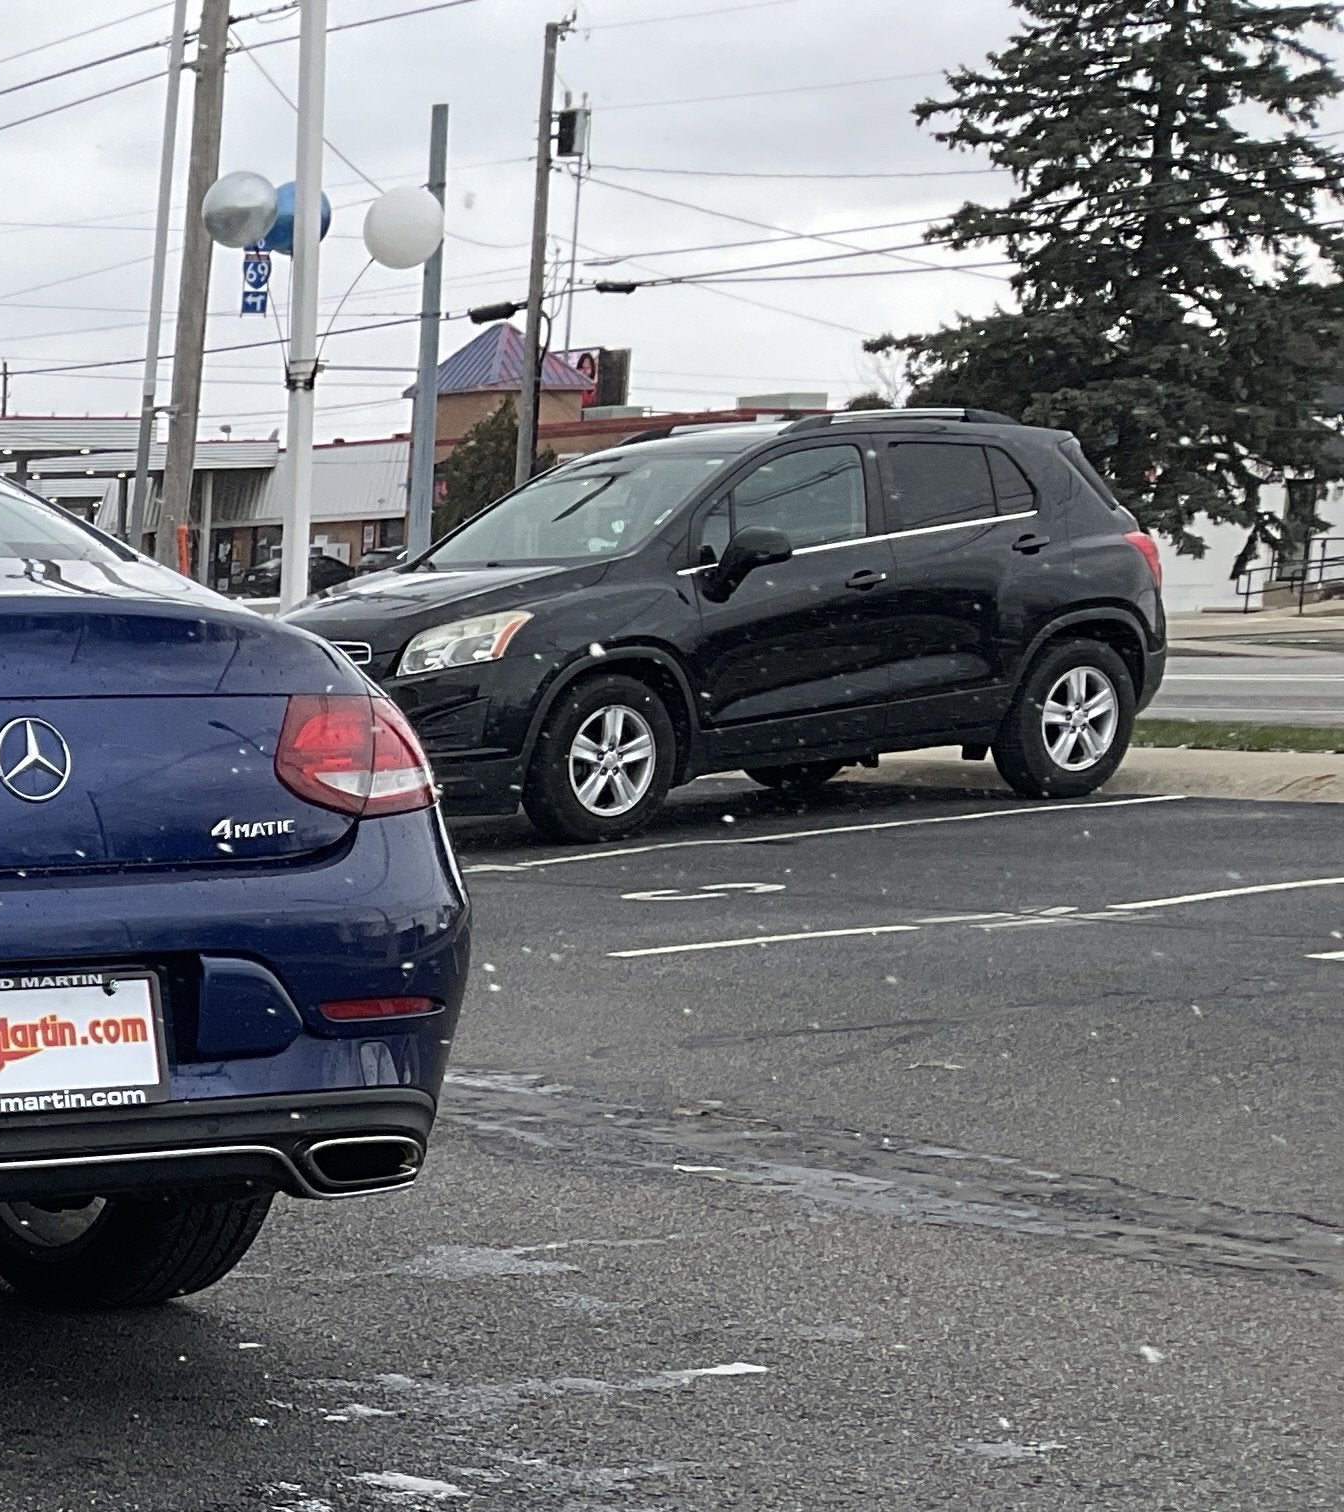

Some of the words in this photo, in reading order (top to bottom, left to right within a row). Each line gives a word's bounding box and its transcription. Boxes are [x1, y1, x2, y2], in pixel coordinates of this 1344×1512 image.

[246, 262, 269, 283] 69
[211, 818, 296, 840] 4MATIC
[20, 974, 103, 989] MARTIN
